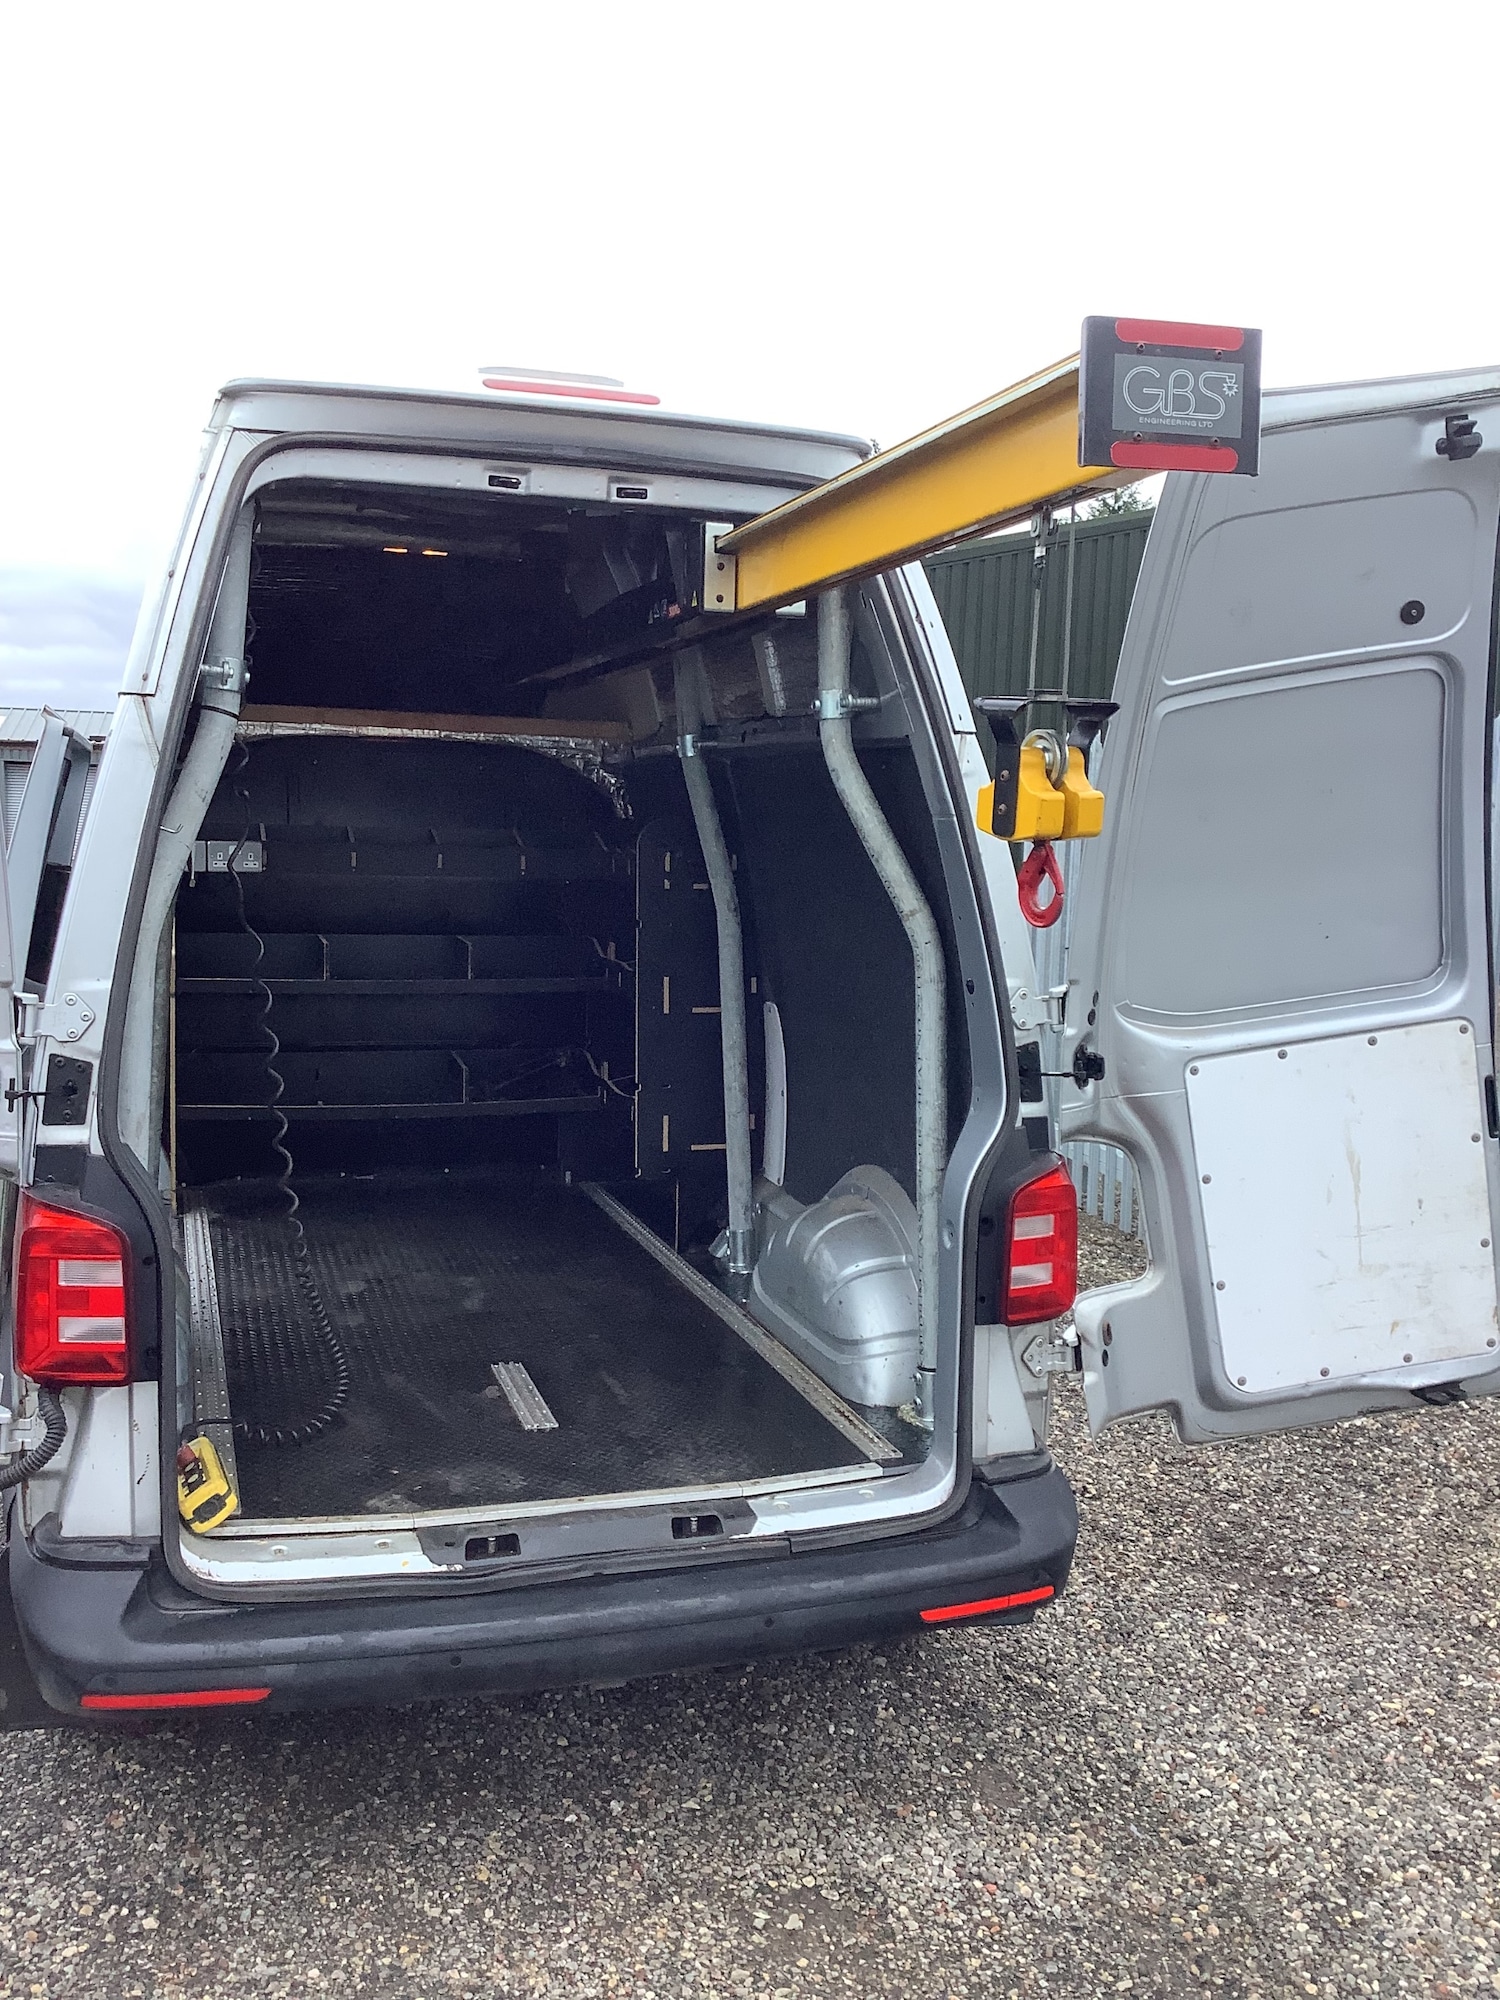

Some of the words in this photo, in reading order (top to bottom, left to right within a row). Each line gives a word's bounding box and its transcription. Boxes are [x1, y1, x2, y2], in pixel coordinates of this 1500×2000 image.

[1123, 366, 1236, 419] GBS
[1139, 416, 1197, 427] ENGINEERING
[1198, 420, 1214, 428] LTD
